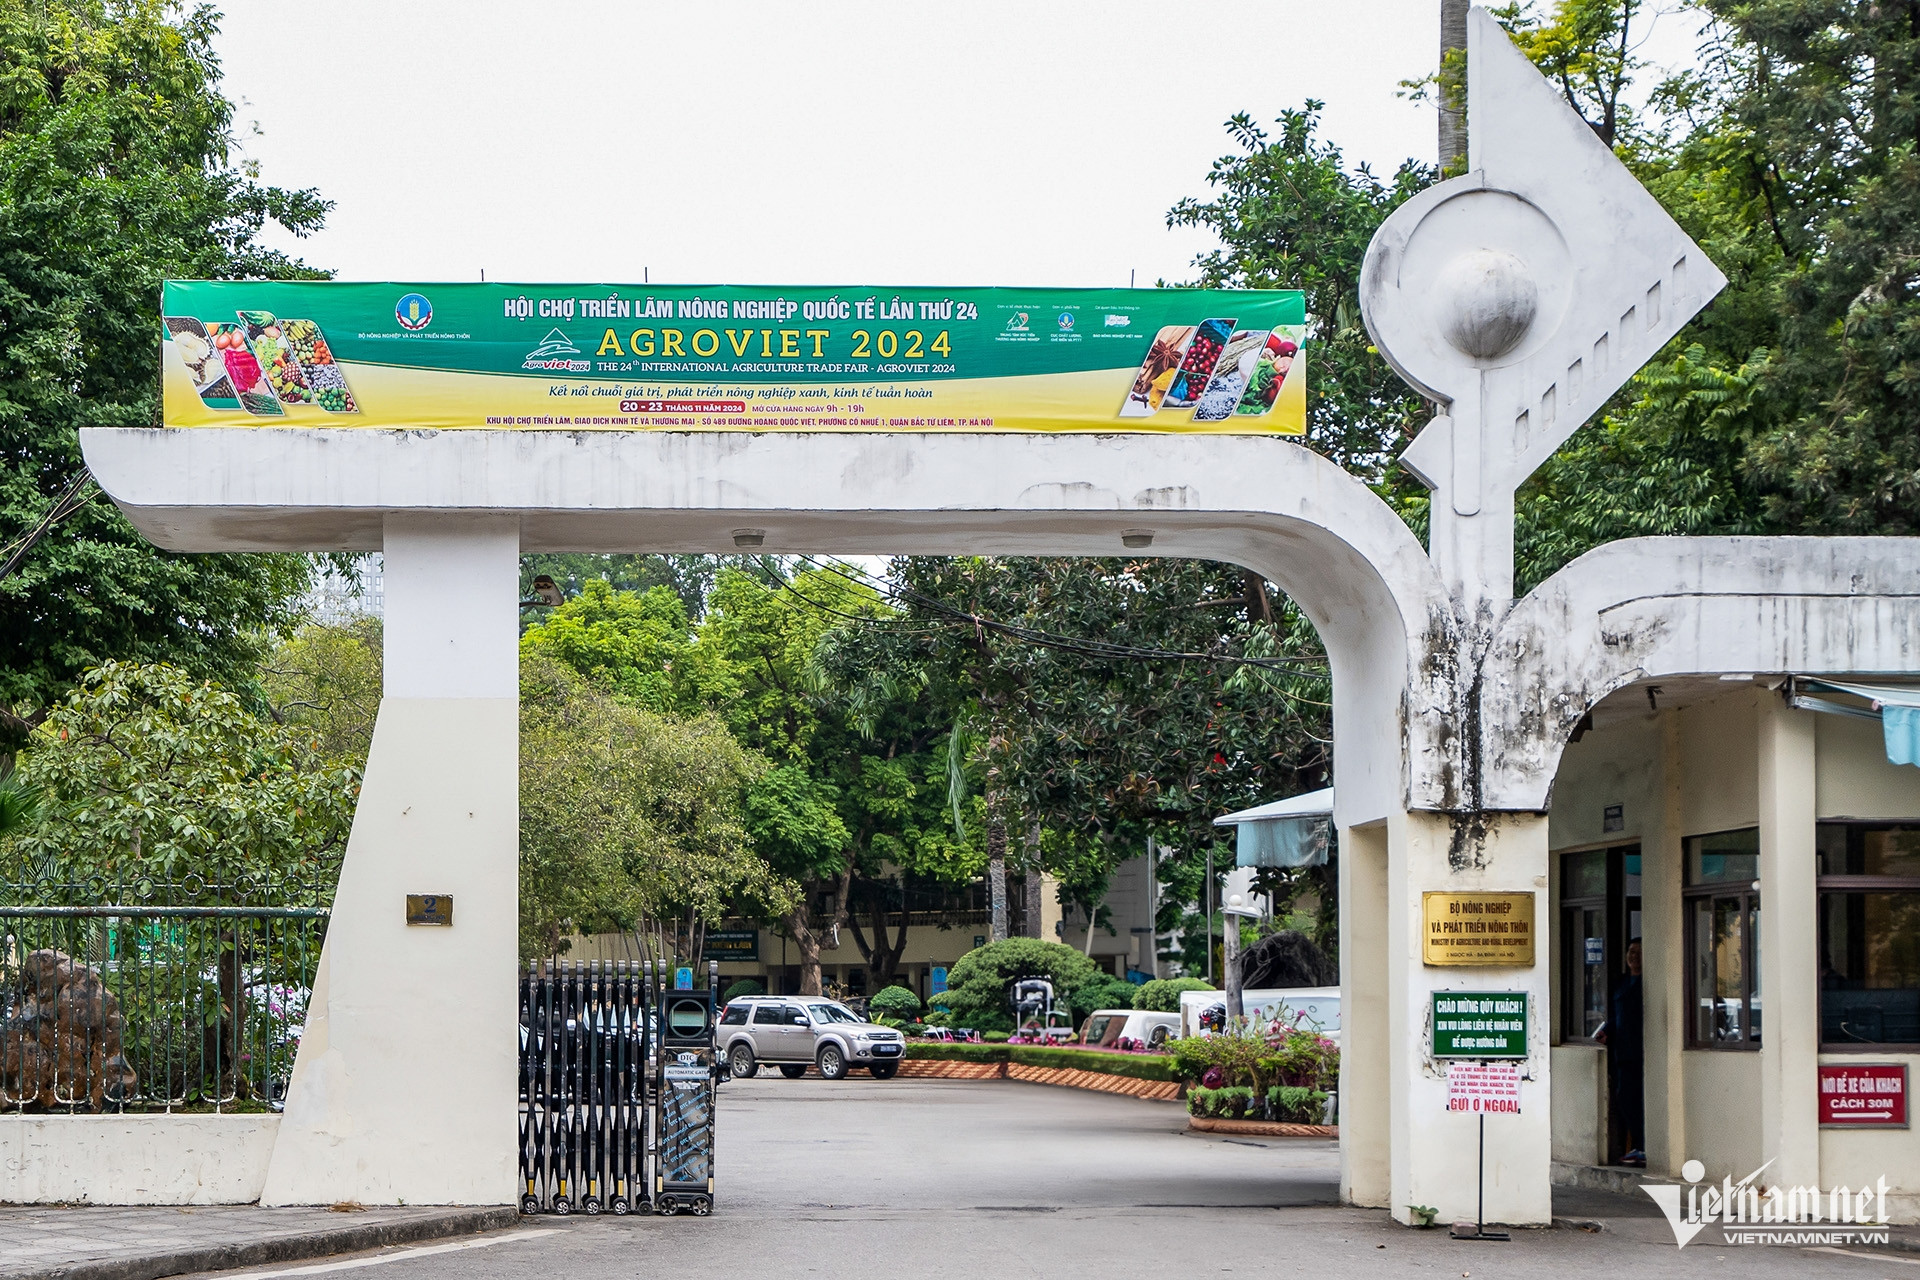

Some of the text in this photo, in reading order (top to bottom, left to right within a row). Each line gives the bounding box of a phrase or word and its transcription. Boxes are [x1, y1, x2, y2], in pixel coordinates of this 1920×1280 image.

[504, 292, 979, 323] HỘI CHỢ TRIỂN LÃM NÔNG NGHIỆP QUỐC TẾ LẦN THỨ 24
[595, 328, 952, 358] AGROVIET 2024
[597, 362, 618, 371] THE
[641, 362, 729, 372] INTERNATIONAL
[731, 363, 804, 373] AGRICULTURE
[806, 364, 842, 373] TRADE
[844, 364, 868, 373] FAIR
[876, 364, 930, 373] AGROVIET
[932, 364, 955, 373] 2024
[549, 384, 933, 399] Kết nối chuỗi giá trị, phát triển nông nghiệp xanh, kinh tế tuần hoàn
[622, 402, 638, 411] 20
[648, 402, 663, 411] 23
[665, 403, 694, 412] THÁNG
[703, 403, 721, 412] NĂM
[424, 897, 436, 913] 2
[1450, 900, 1512, 916] BỘ NÔNG NGHIỆP
[1431, 917, 1529, 933] VÀ PHÁT TRIỂN NÔNG THÔN
[1437, 997, 1456, 1013] CHÀO
[1457, 997, 1479, 1013] MỪNG
[1495, 998, 1519, 1013] KHÁCH
[1836, 1071, 1848, 1093] ĐỂ
[1848, 1077, 1858, 1093] XE
[1859, 1071, 1875, 1093] CỦA
[1451, 1095, 1518, 1112] GỬI Ở NGOÀI
[1830, 1097, 1894, 1108] CÁCH 30M
